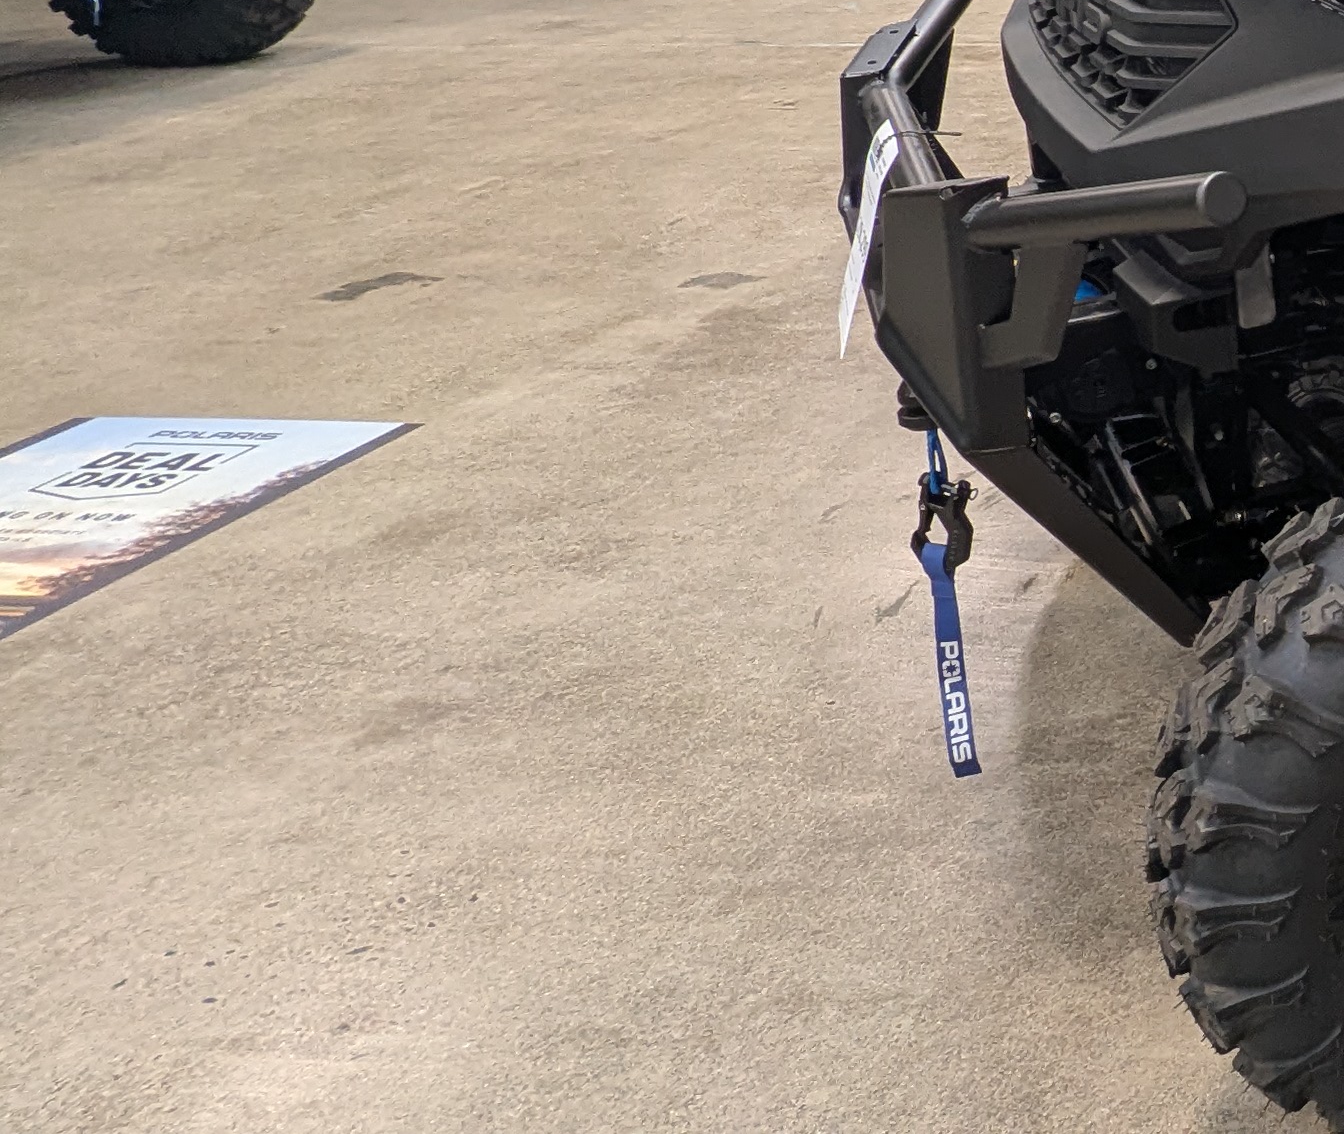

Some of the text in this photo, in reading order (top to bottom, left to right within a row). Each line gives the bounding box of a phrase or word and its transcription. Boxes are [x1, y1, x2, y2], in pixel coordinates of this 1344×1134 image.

[148, 429, 284, 441] POLARIS
[79, 451, 226, 472] DEAL
[54, 472, 179, 489] DAYS
[33, 511, 74, 521] ON
[74, 512, 138, 522] NOW
[939, 640, 973, 764] POLARIS
